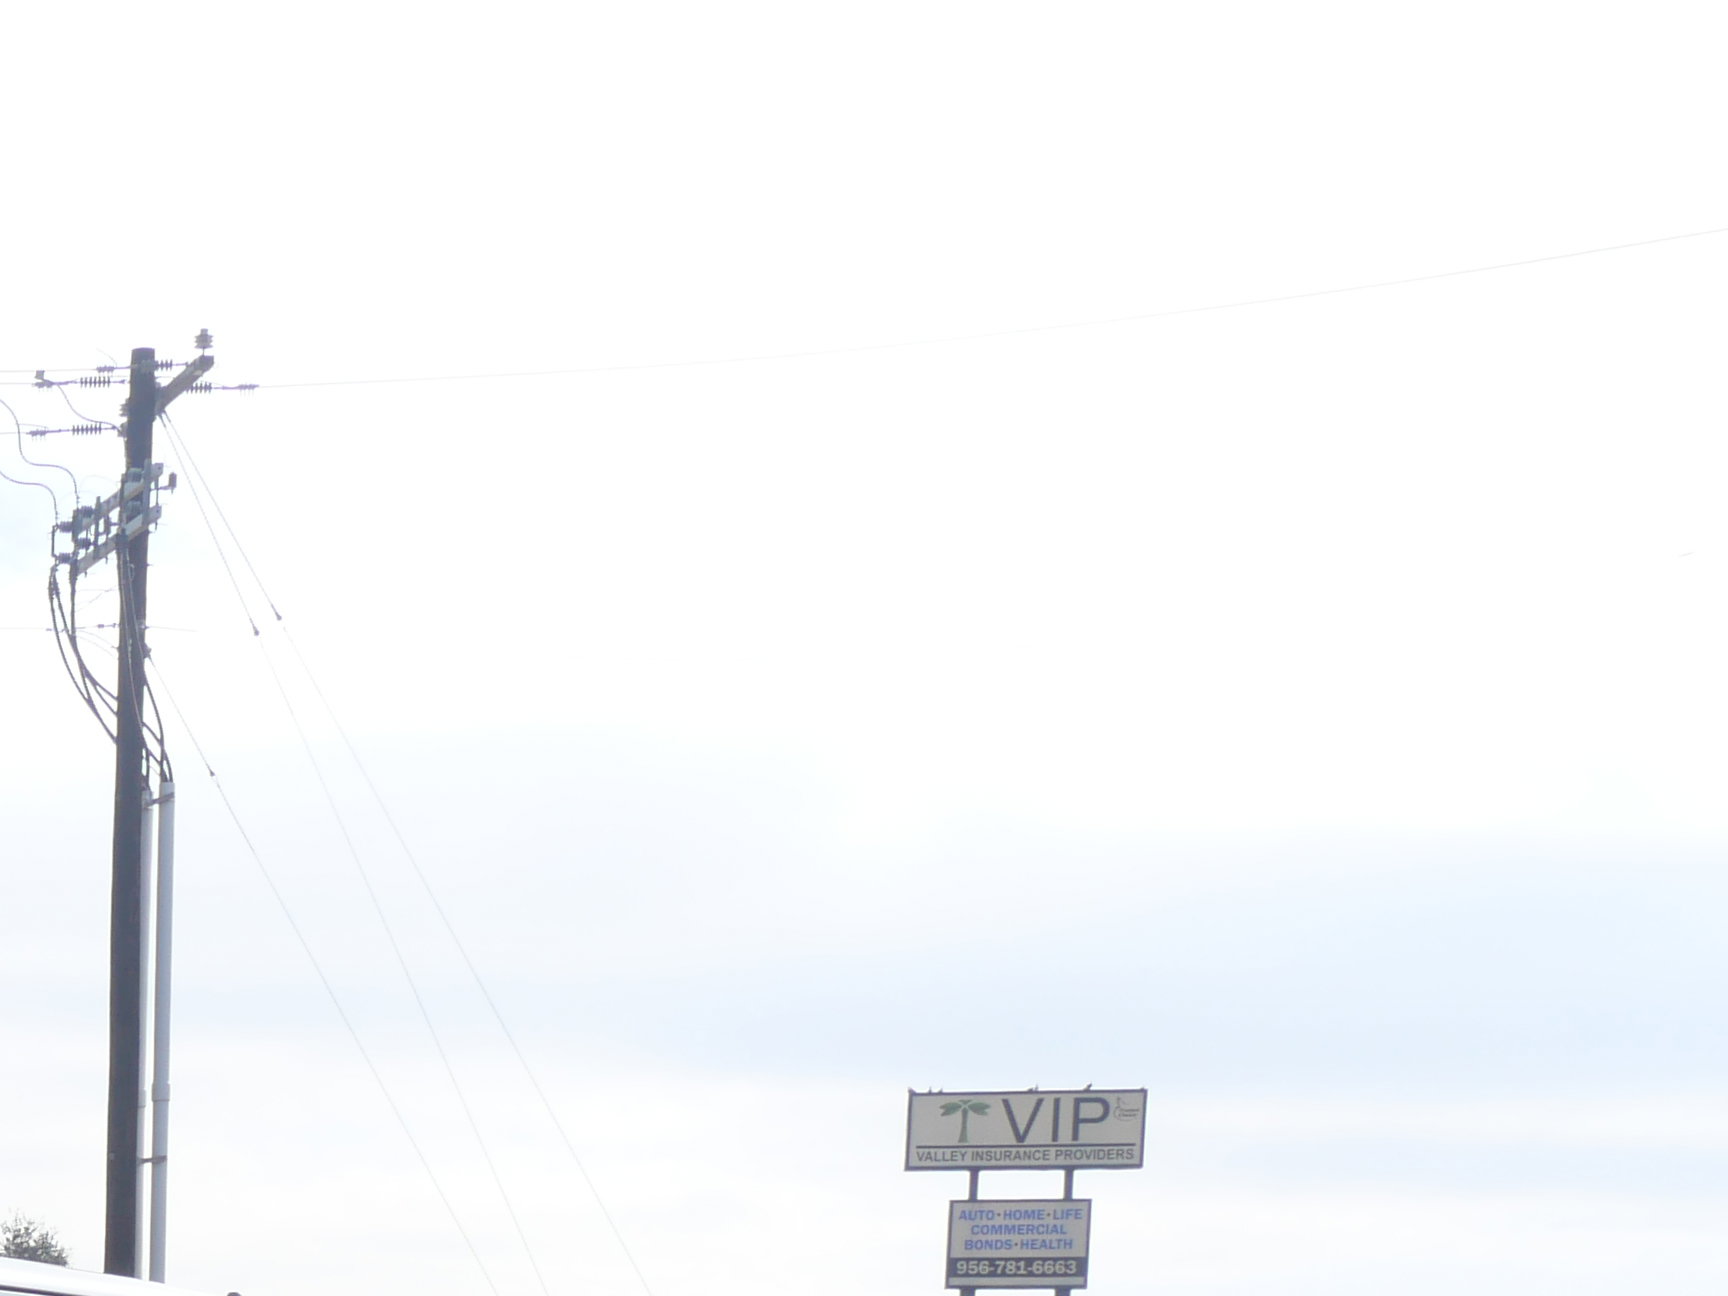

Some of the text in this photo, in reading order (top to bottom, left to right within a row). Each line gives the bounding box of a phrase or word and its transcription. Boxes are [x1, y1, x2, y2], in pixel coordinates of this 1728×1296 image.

[1002, 1097, 1110, 1144] VIP
[916, 1148, 1135, 1163] VALLEY INSURANCE PROVIDERS
[958, 1208, 1084, 1221] AUTO HOME LIFE
[970, 1223, 1068, 1236] COMMERCIAL
[964, 1238, 1074, 1251] BONDS HEALTH
[956, 1260, 1077, 1276] 956-781-6663
